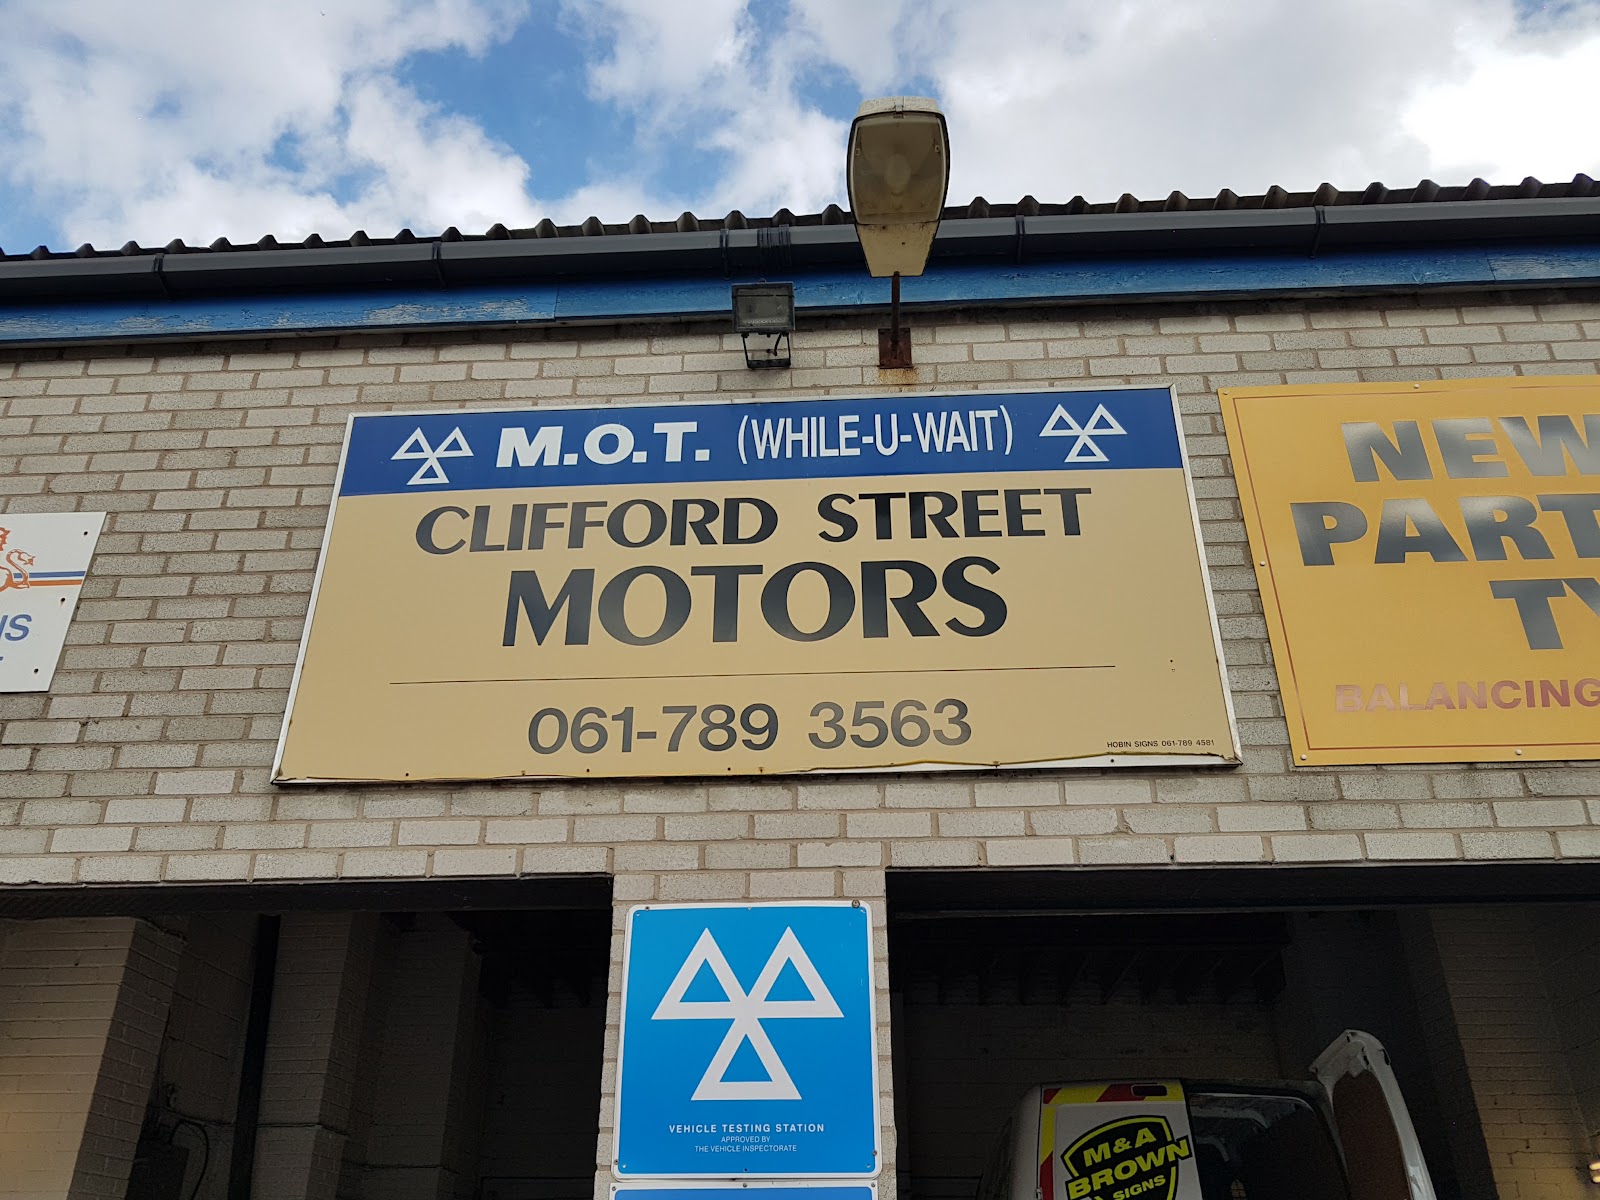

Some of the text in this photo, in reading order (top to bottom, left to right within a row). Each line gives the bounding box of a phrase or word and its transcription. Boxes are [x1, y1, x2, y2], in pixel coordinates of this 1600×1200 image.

[496, 405, 1013, 467] M.O.T. (WHILE-U-WAIT)
[1341, 414, 1600, 482] NEW
[415, 487, 1092, 555] CLIFFORD STREET
[502, 555, 1008, 647] MOTORS
[1335, 678, 1600, 713] BALANCING
[528, 698, 972, 755] 061-789 3563
[669, 1123, 825, 1133] VEHICLE TESTING STATION
[694, 1144, 798, 1153] THE VEHICLE INSPECTORATE
[720, 1135, 771, 1143] APPROVED BY
[1083, 1127, 1157, 1167] M&A
[1068, 1139, 1190, 1199] BROWN
[1113, 1175, 1166, 1200] SIGNS
